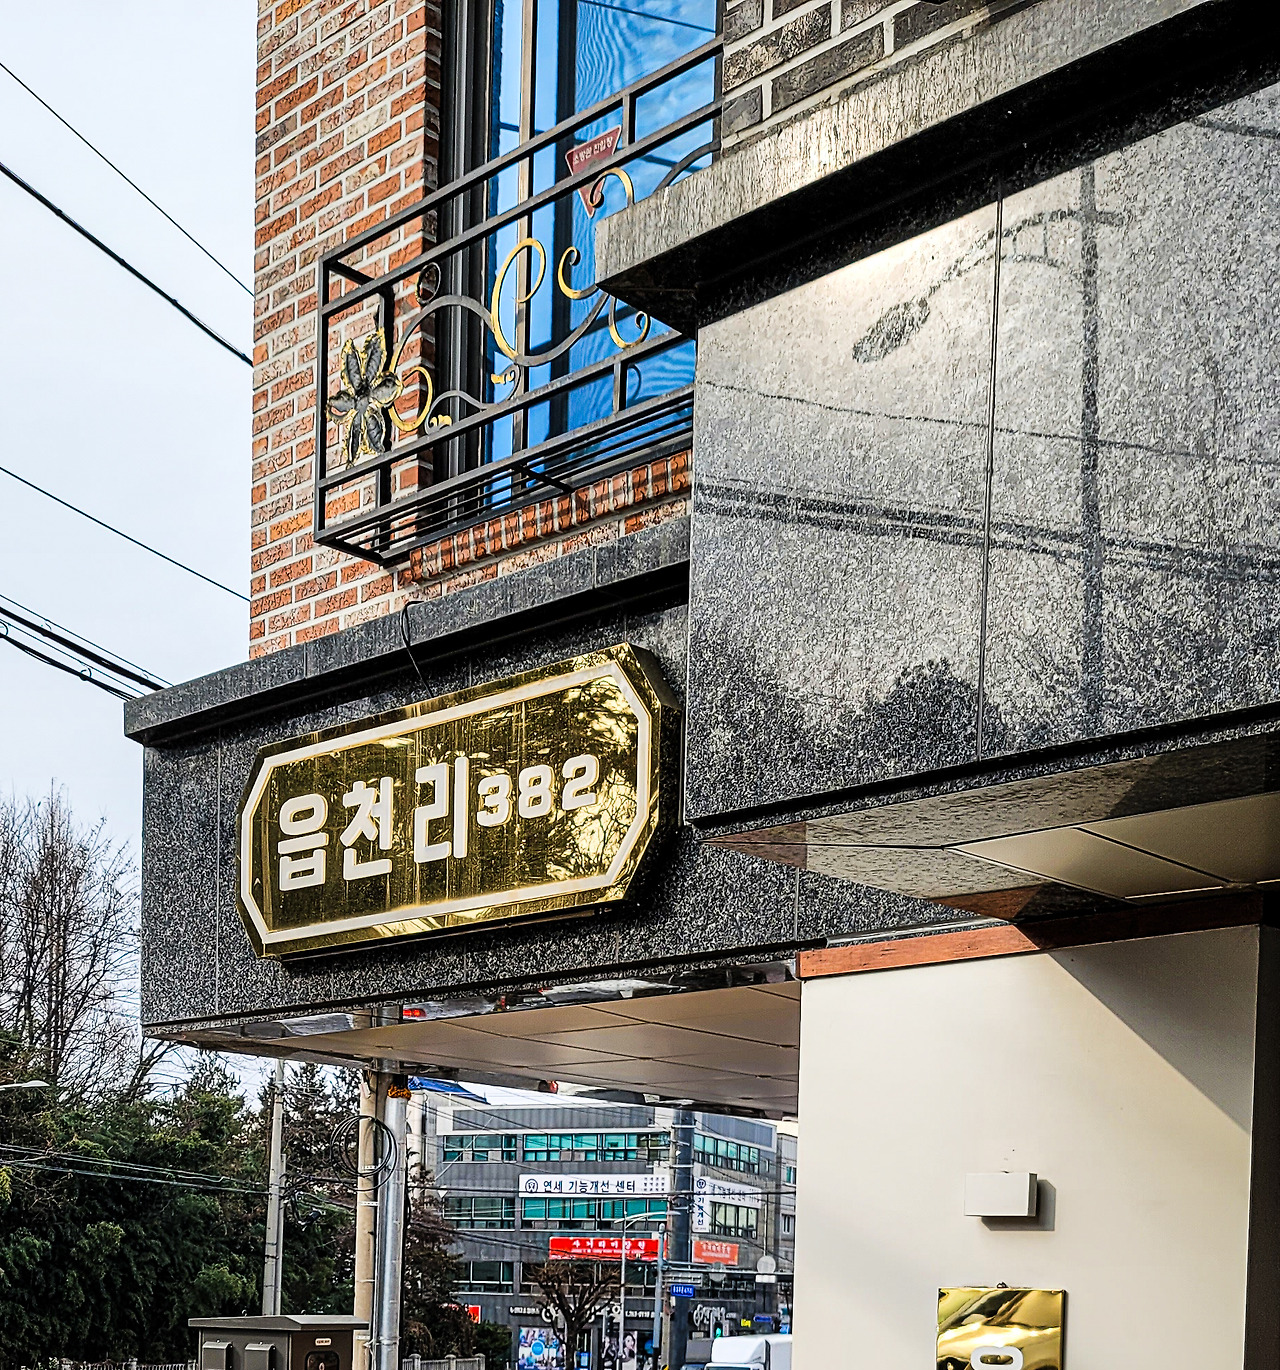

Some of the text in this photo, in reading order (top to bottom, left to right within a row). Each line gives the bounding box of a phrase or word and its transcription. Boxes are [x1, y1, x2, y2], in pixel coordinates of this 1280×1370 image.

[543, 1180, 563, 1193] 연세
[568, 1180, 610, 1194] 기능개선
[615, 1180, 636, 1193] 센터
